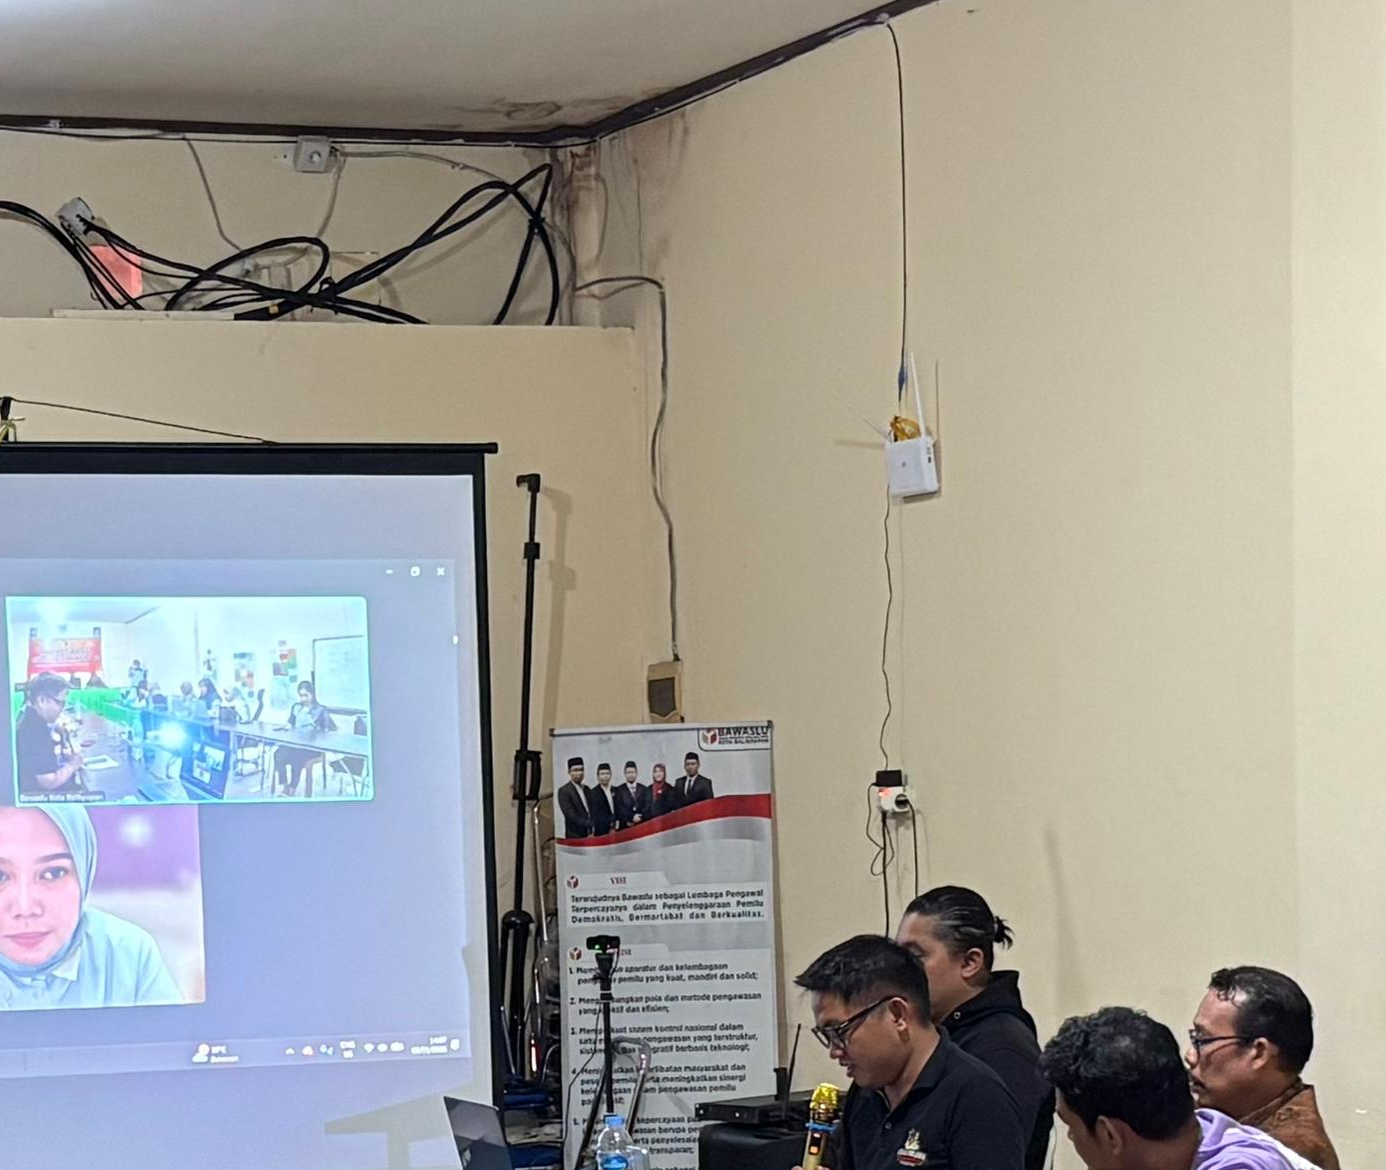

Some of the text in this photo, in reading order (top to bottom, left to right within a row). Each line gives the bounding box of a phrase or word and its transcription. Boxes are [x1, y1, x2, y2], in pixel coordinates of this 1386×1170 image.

[725, 888, 764, 898] Pengawal
[689, 911, 705, 920] dan
[719, 972, 735, 980] dan
